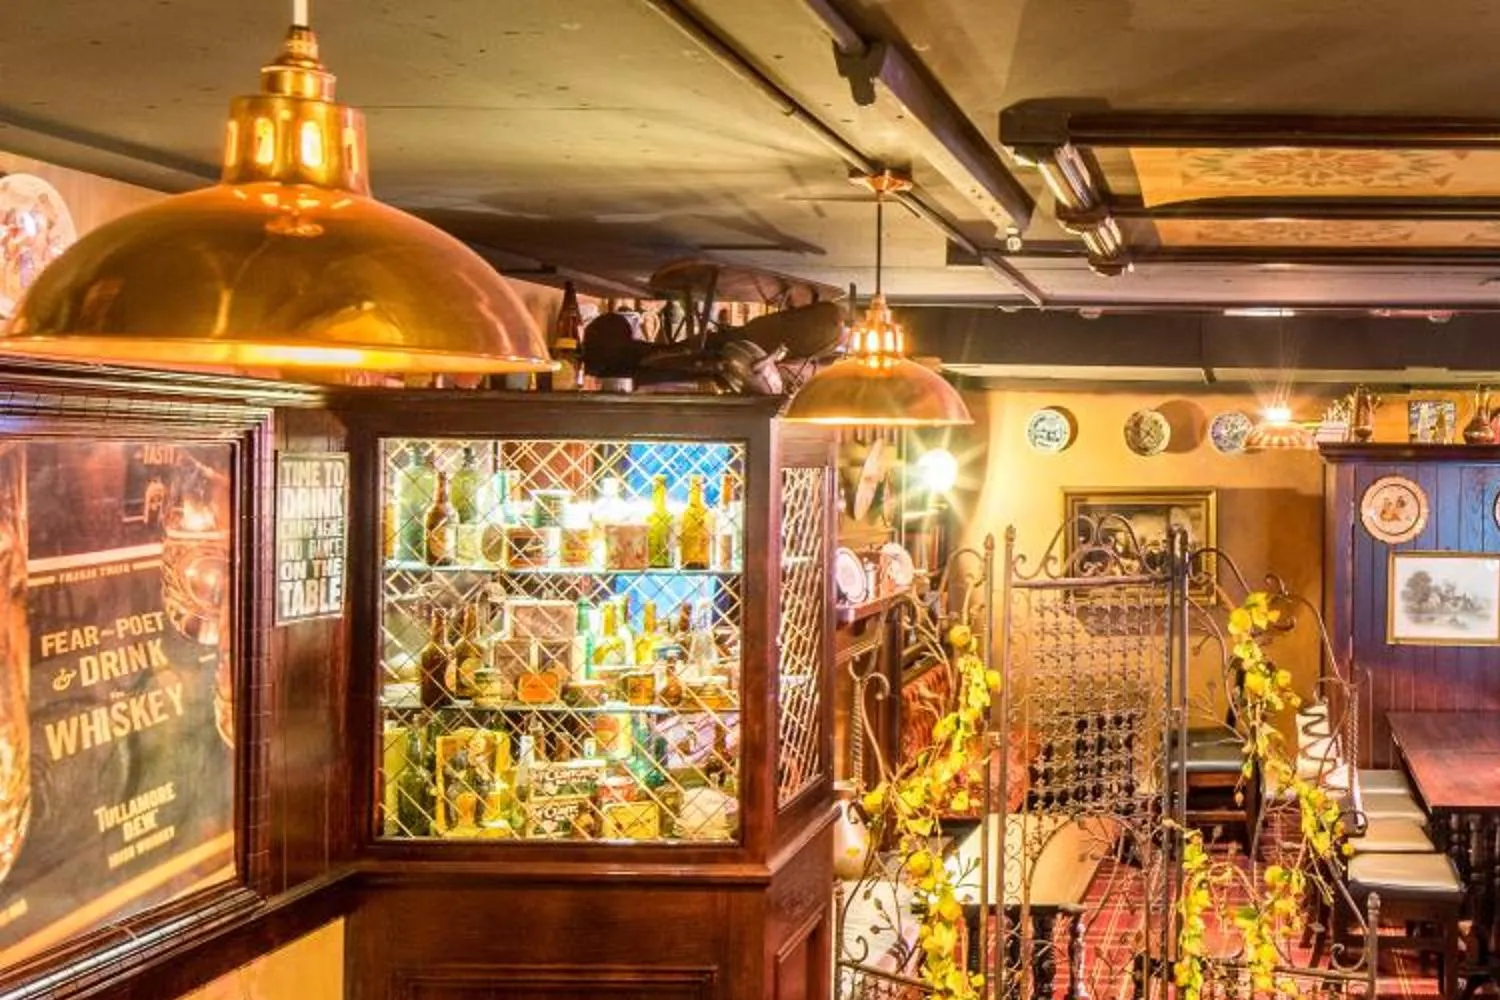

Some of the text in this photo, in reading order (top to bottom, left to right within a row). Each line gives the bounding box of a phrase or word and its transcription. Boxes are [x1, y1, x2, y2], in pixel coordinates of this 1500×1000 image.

[281, 460, 345, 488] TIME TO
[281, 487, 343, 520] DRINK
[280, 558, 343, 581] ON THE
[280, 577, 341, 618] TABLE
[40, 611, 166, 657] FEAR POET
[79, 638, 169, 687] DRINK
[45, 682, 184, 761] WHISKEY
[93, 782, 176, 833] TULLAMORE
